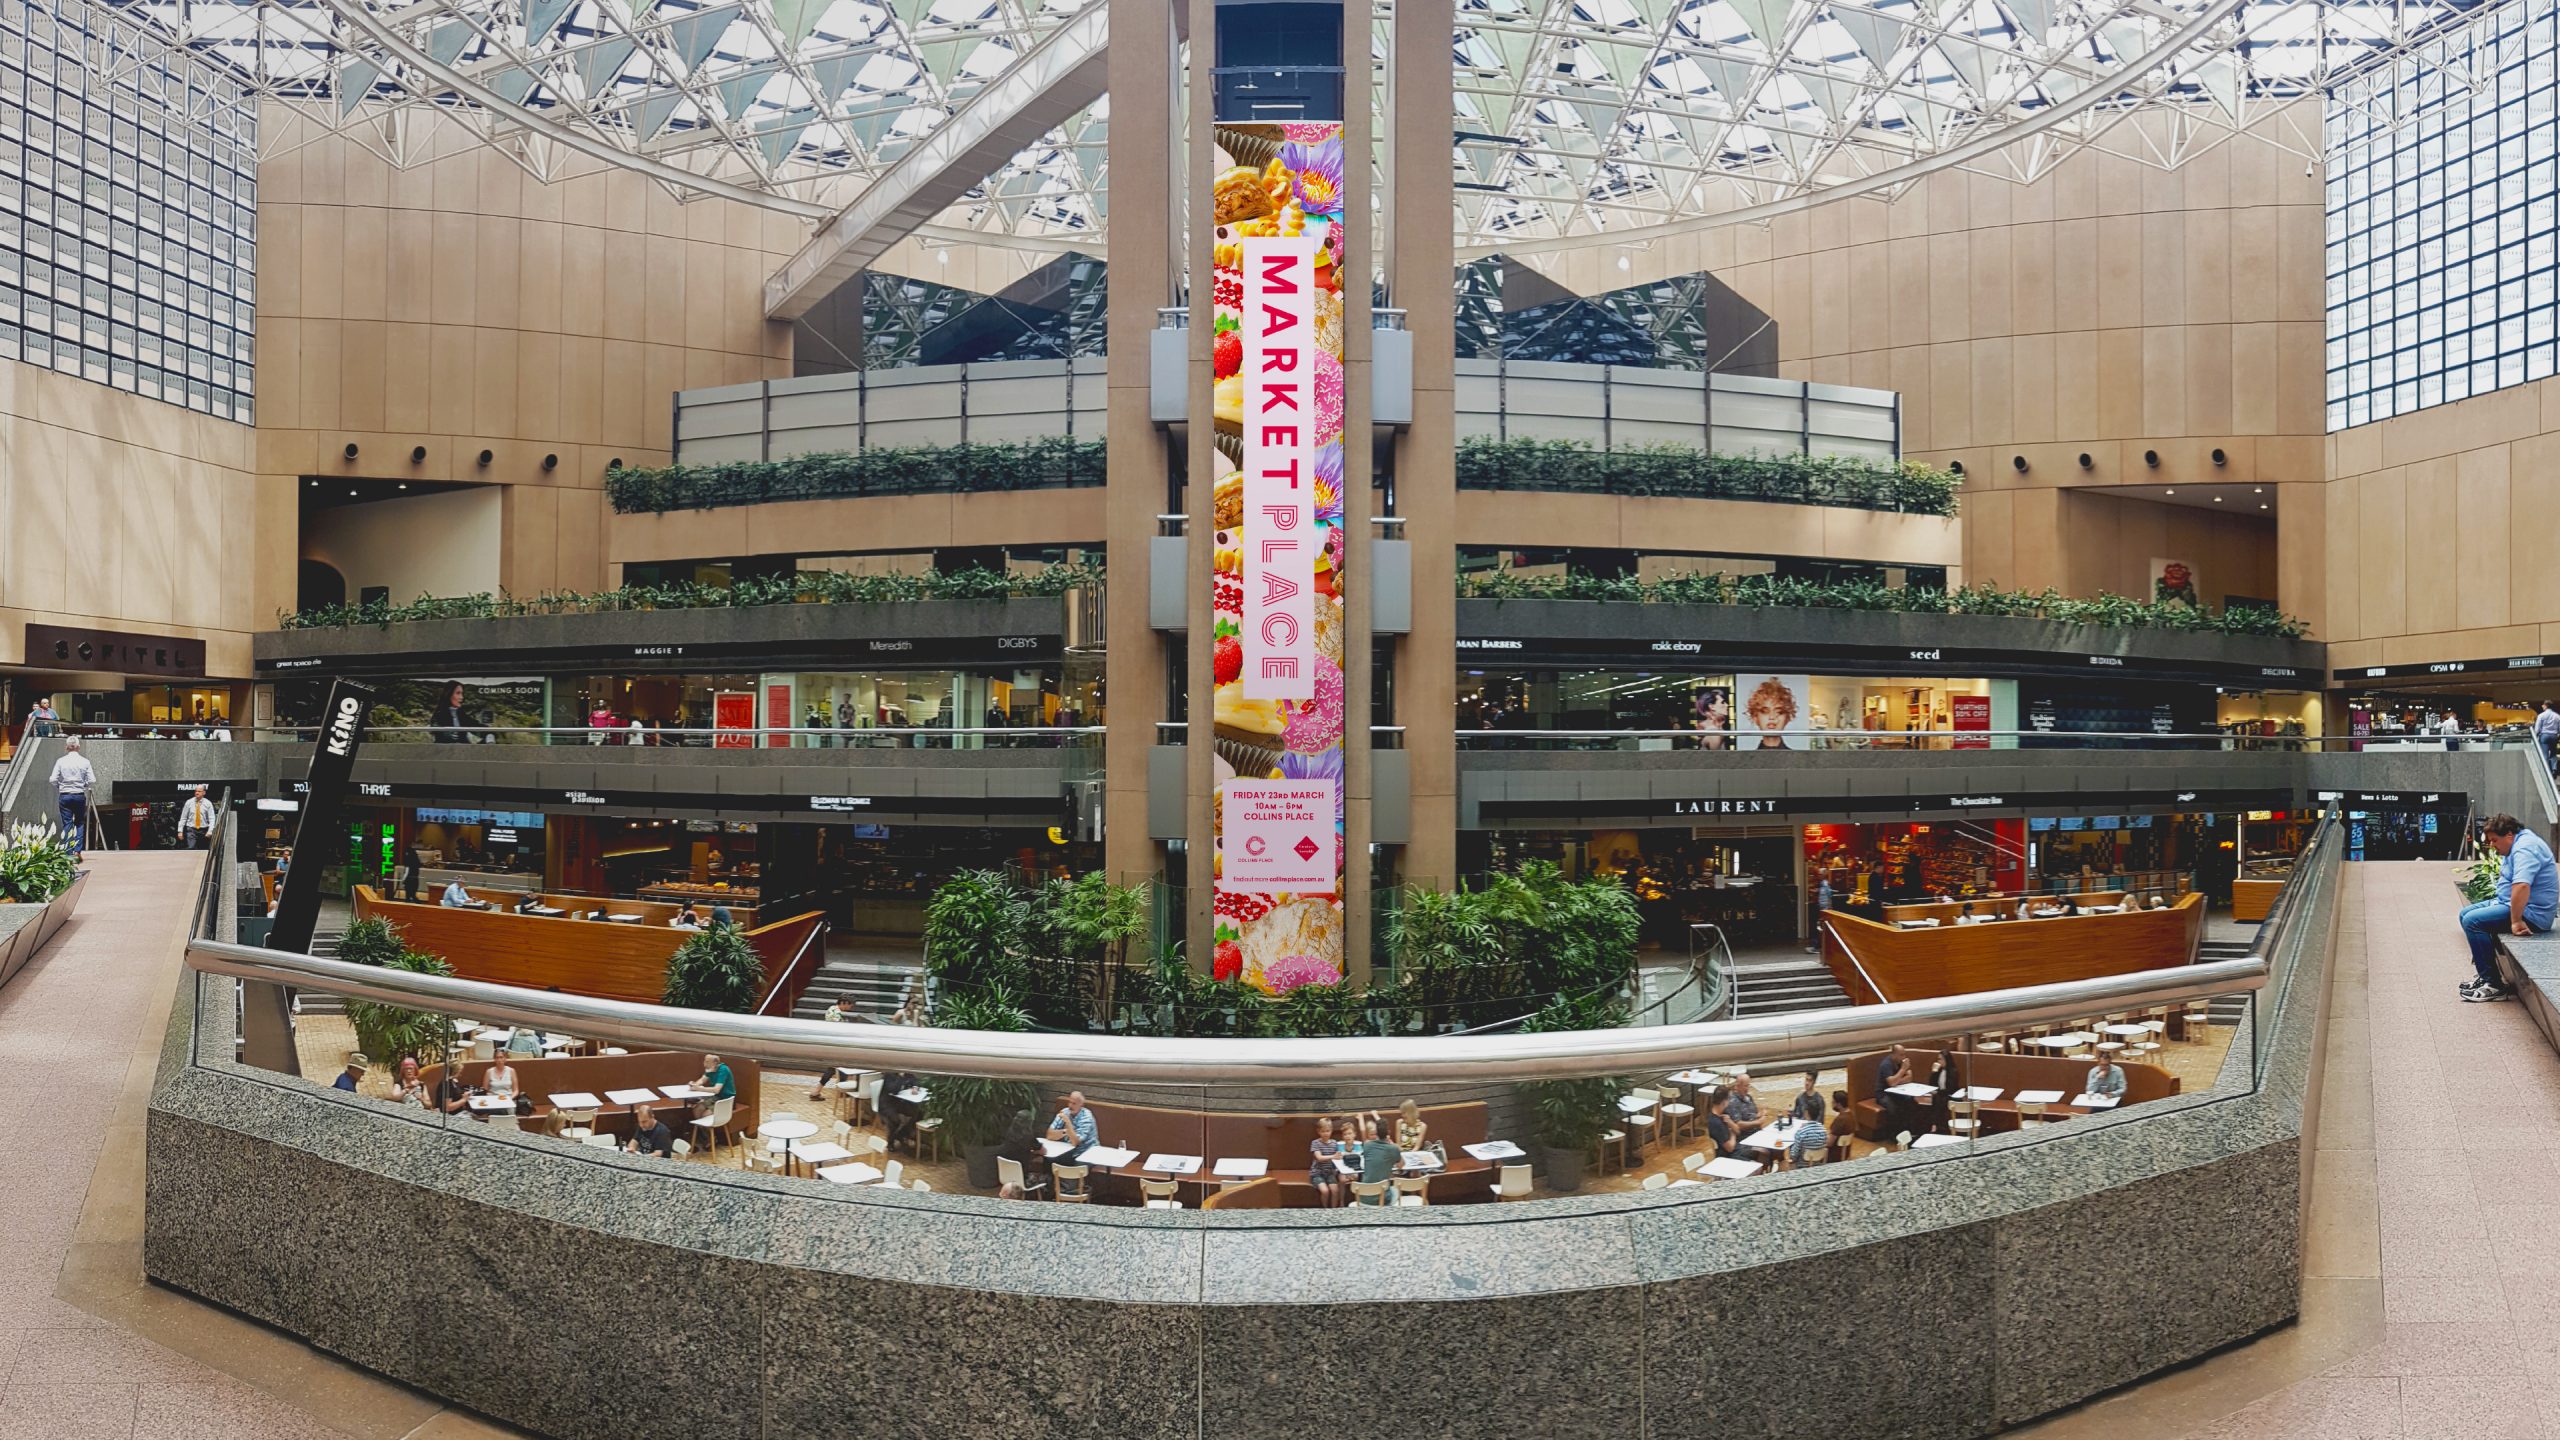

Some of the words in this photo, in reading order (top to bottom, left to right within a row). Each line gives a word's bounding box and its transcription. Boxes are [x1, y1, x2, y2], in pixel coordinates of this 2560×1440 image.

[1261, 255, 1298, 489] MARKET
[1261, 504, 1298, 679] PLACE
[869, 640, 912, 650] Meredith
[998, 638, 1038, 648] DIGBYS
[1673, 641, 1702, 653] ebony
[56, 640, 186, 668] SOFITEL
[1910, 649, 1940, 660] seed
[2430, 664, 2448, 673] OPSM
[565, 790, 586, 798] asian
[1676, 800, 1776, 813] LAURENT
